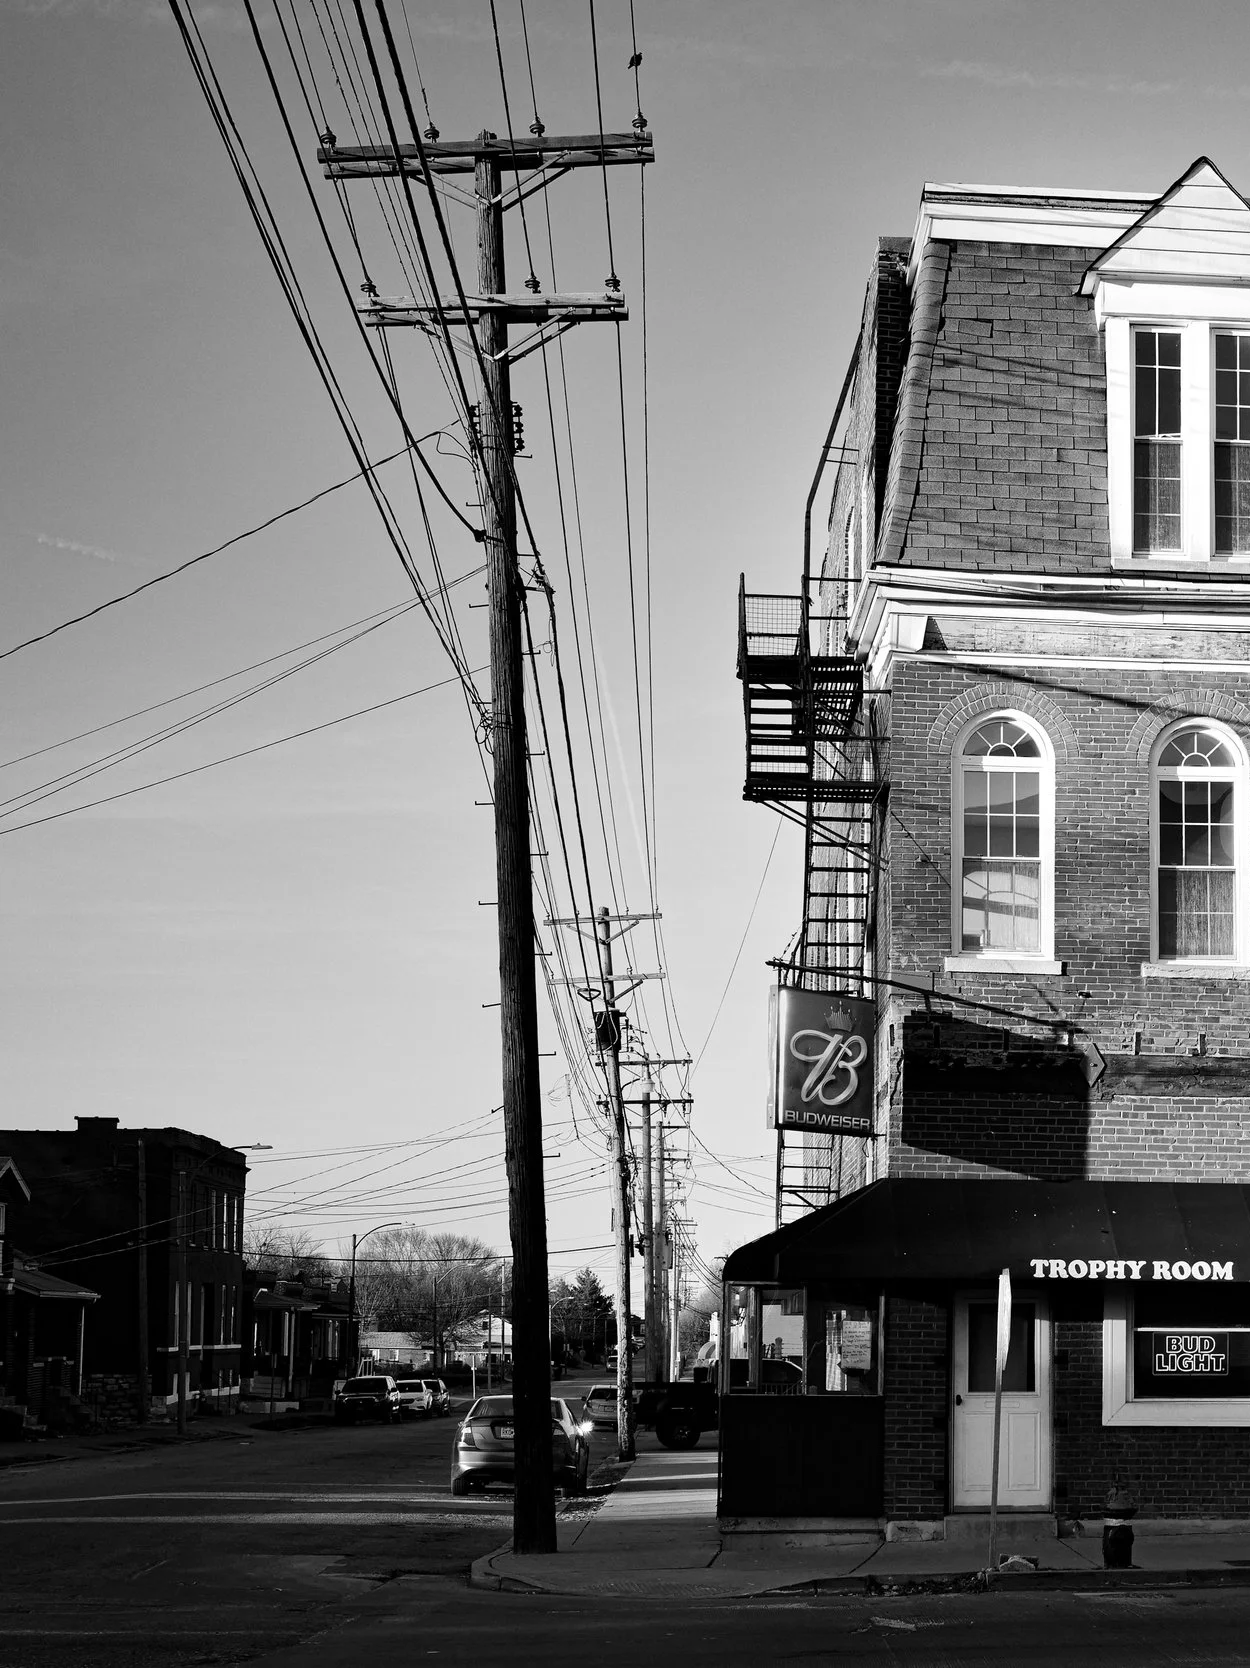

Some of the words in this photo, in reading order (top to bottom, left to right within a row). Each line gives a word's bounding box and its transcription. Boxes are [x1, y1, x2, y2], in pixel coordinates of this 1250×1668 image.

[784, 1110, 870, 1129] BUDWEISER
[1030, 1259, 1147, 1280] TROPHY
[1152, 1261, 1234, 1281] ROOM
[1165, 1335, 1216, 1354] BUD
